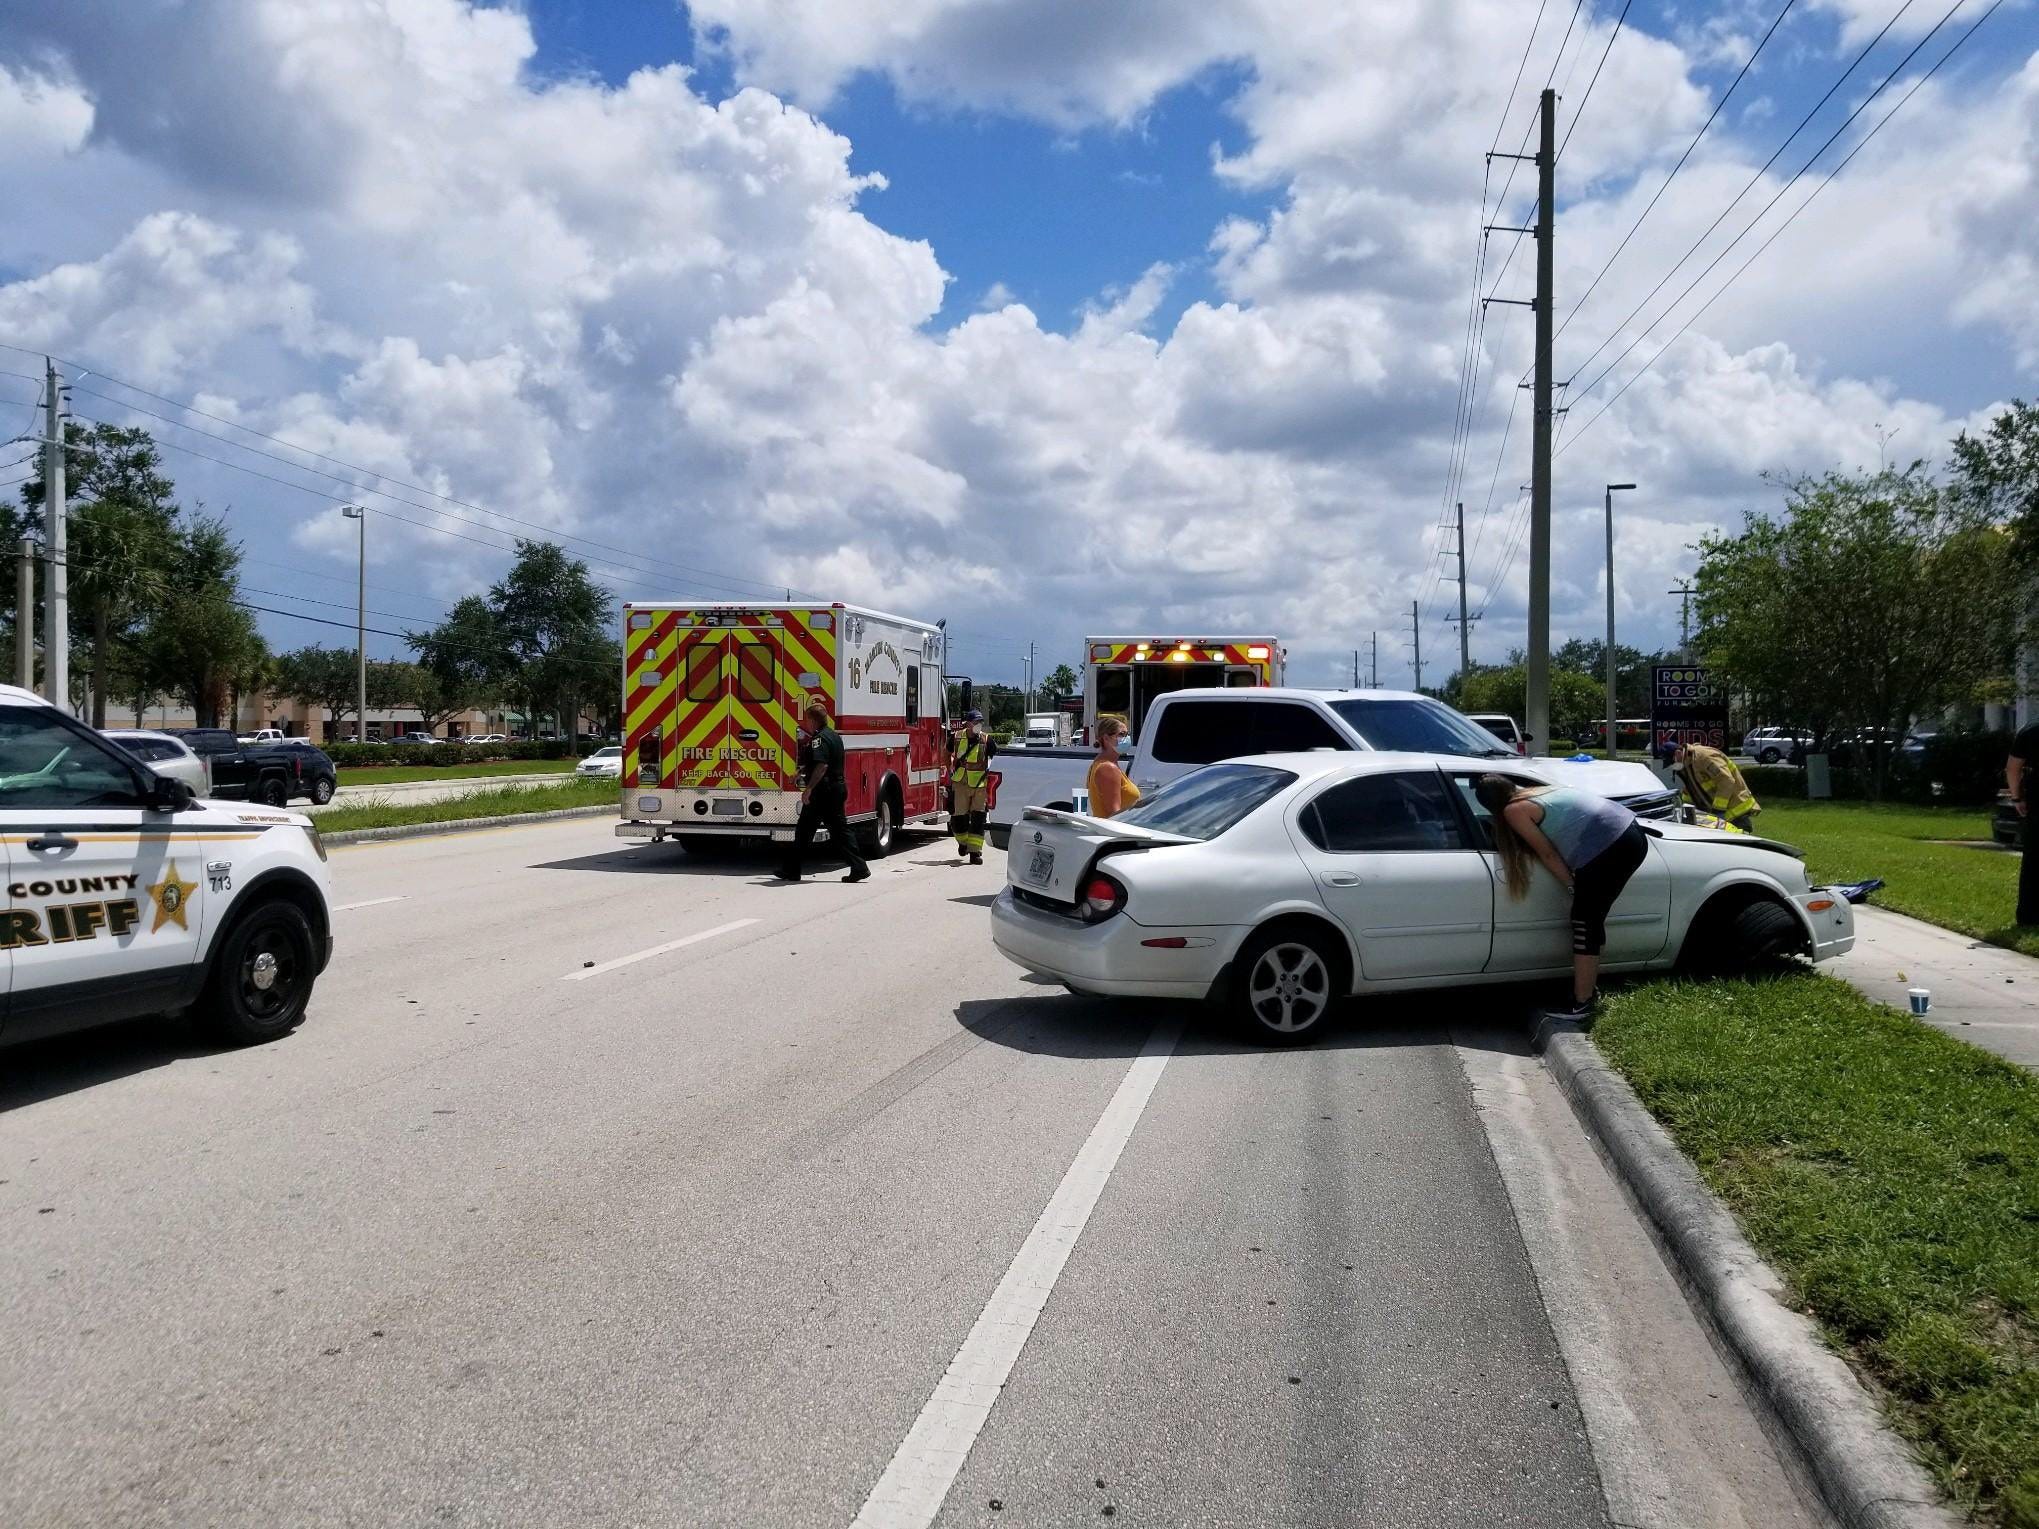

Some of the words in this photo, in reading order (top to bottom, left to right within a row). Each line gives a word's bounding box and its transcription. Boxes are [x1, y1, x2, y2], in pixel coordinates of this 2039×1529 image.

[848, 657, 861, 689] 16
[1662, 671, 1709, 682] ROOM
[1663, 685, 1681, 697] TO
[1684, 685, 1709, 697] GO
[1656, 720, 1690, 728] ROOMS
[1694, 720, 1706, 728] TO
[1708, 720, 1724, 728] GO
[1656, 728, 1725, 751] KIDS
[682, 747, 713, 760] FIRE
[719, 748, 777, 761] RESCUE
[707, 770, 731, 779] BACK
[733, 770, 753, 779] 500
[755, 771, 777, 779] FEET
[8, 873, 140, 898] COUNTY
[209, 875, 232, 892] 713
